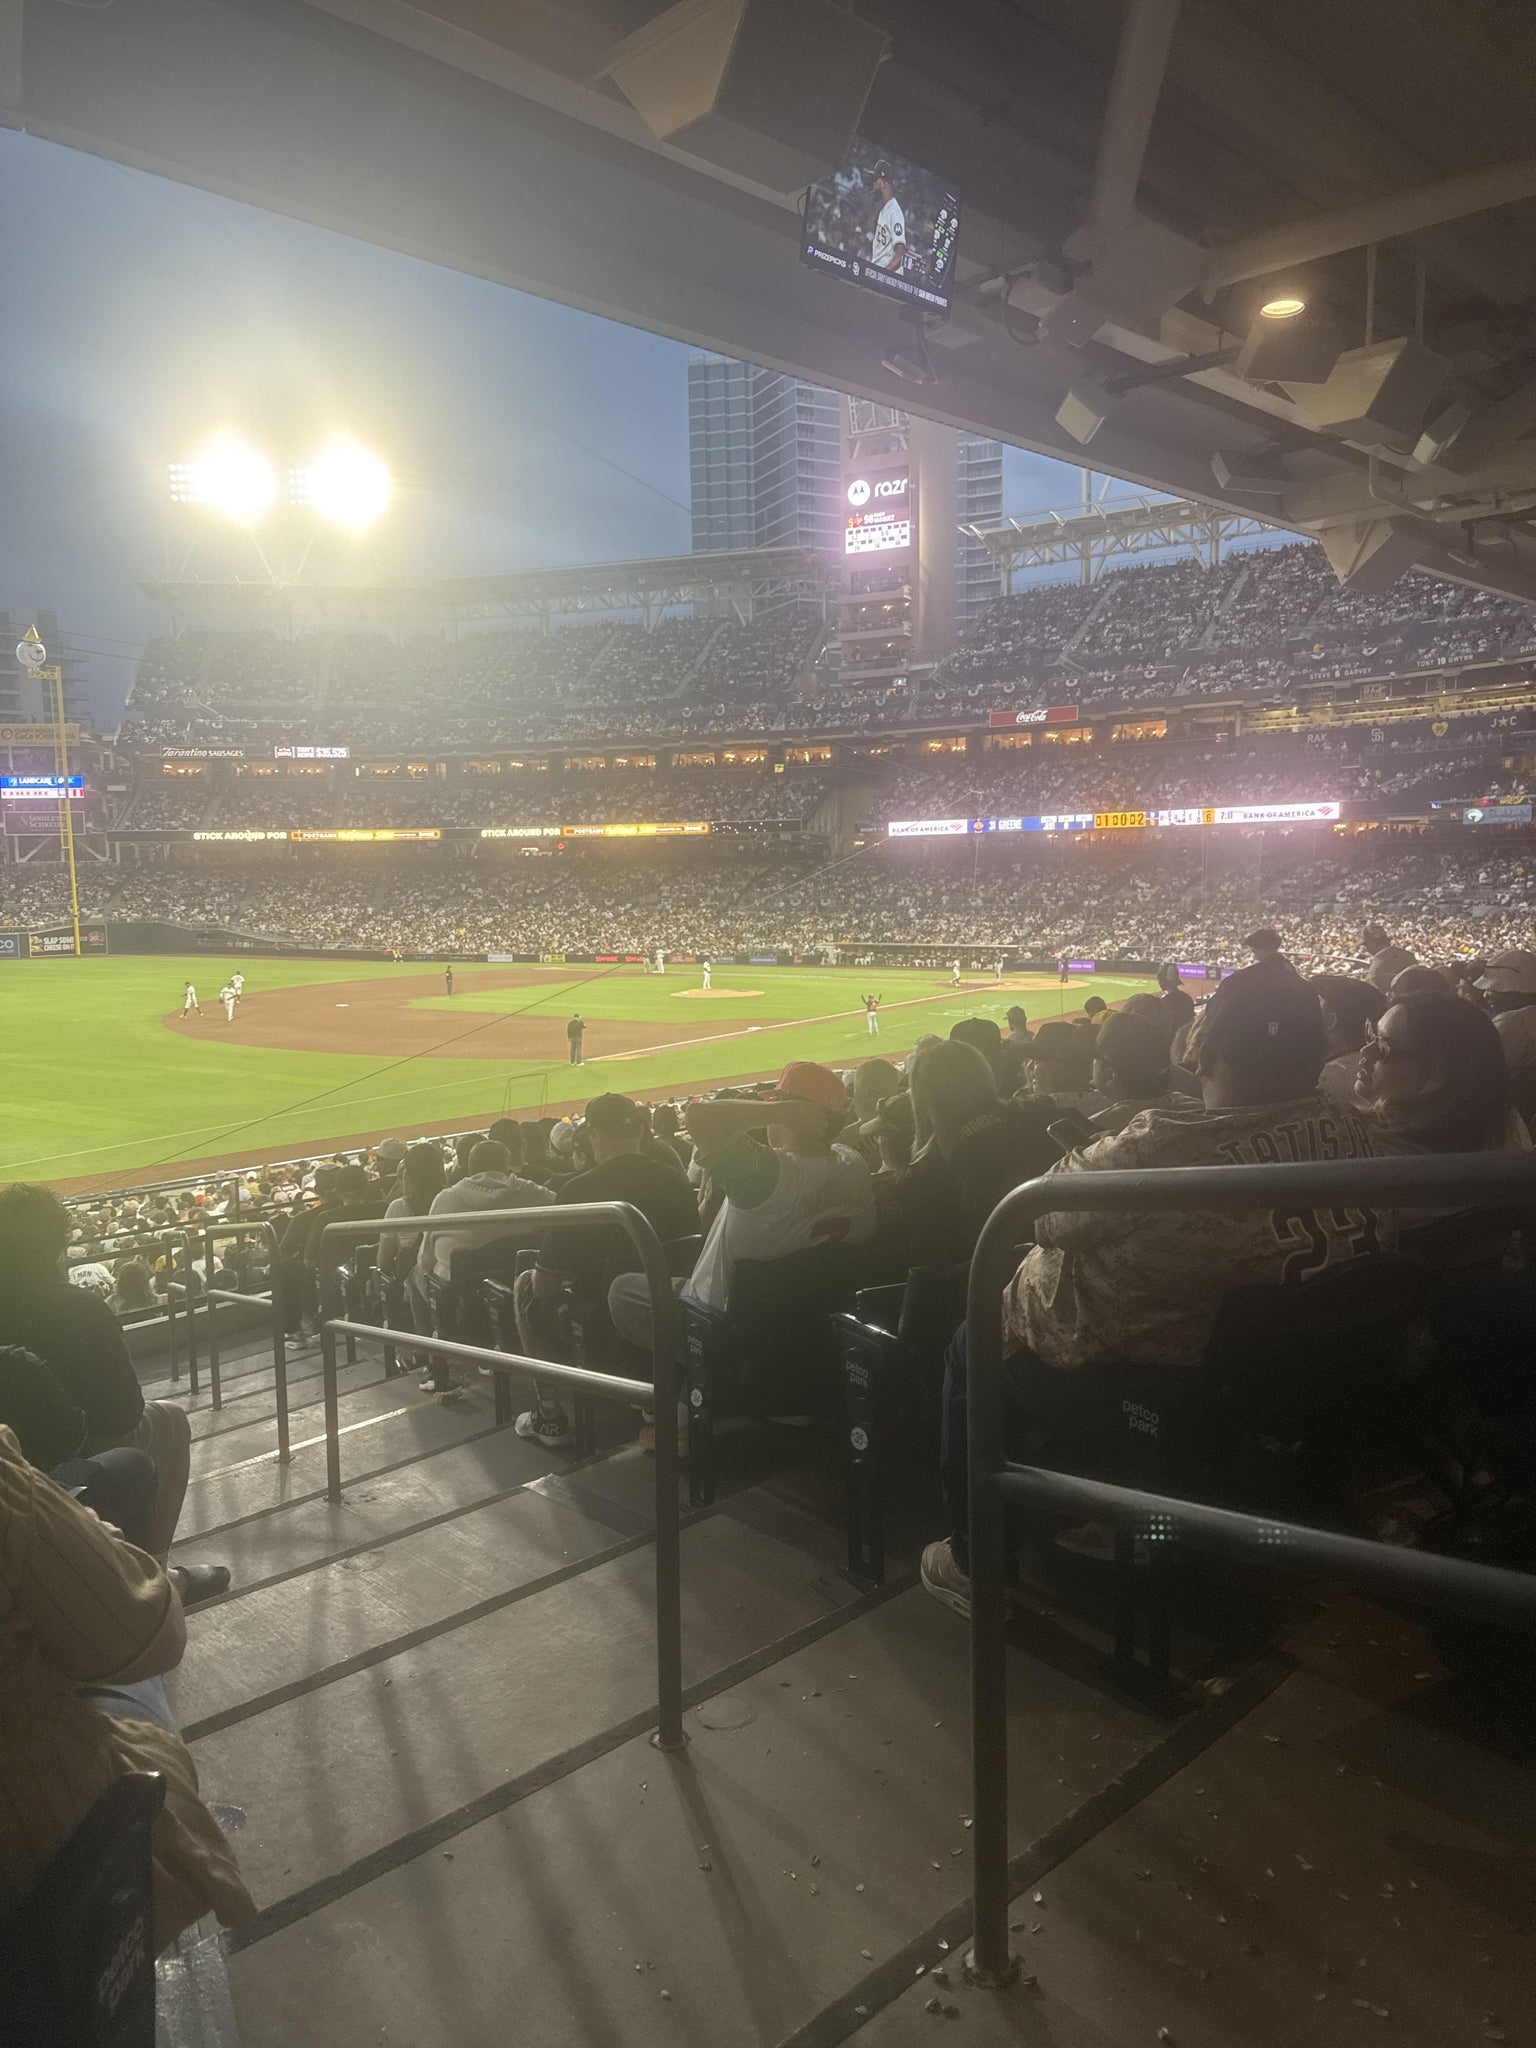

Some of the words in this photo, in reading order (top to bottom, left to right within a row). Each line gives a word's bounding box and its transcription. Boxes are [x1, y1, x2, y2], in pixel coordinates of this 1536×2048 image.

[874, 478, 908, 498] razr
[1417, 659, 1434, 667] TONY
[1437, 656, 1446, 665] 19
[1448, 653, 1474, 664] GWYNN
[1309, 671, 1331, 680] STEVE
[1334, 670, 1341, 678] 6
[1344, 666, 1372, 677] GARVEY
[1307, 733, 1328, 744] RAK
[162, 747, 207, 757] Tarantino
[1277, 810, 1315, 818] AMERICA
[193, 832, 223, 840] STICK
[224, 832, 265, 840] AROUND
[266, 832, 287, 840] FOR
[481, 830, 506, 838] STICK
[506, 829, 541, 837] AROUND
[542, 828, 560, 836] FOR
[43, 937, 58, 945] SLAP
[58, 936, 74, 944] SOME
[1218, 1117, 1339, 1166] TATIS
[846, 1361, 869, 1379] petco
[850, 1373, 869, 1390] park
[1122, 1400, 1159, 1425] petco
[1129, 1416, 1159, 1439] park
